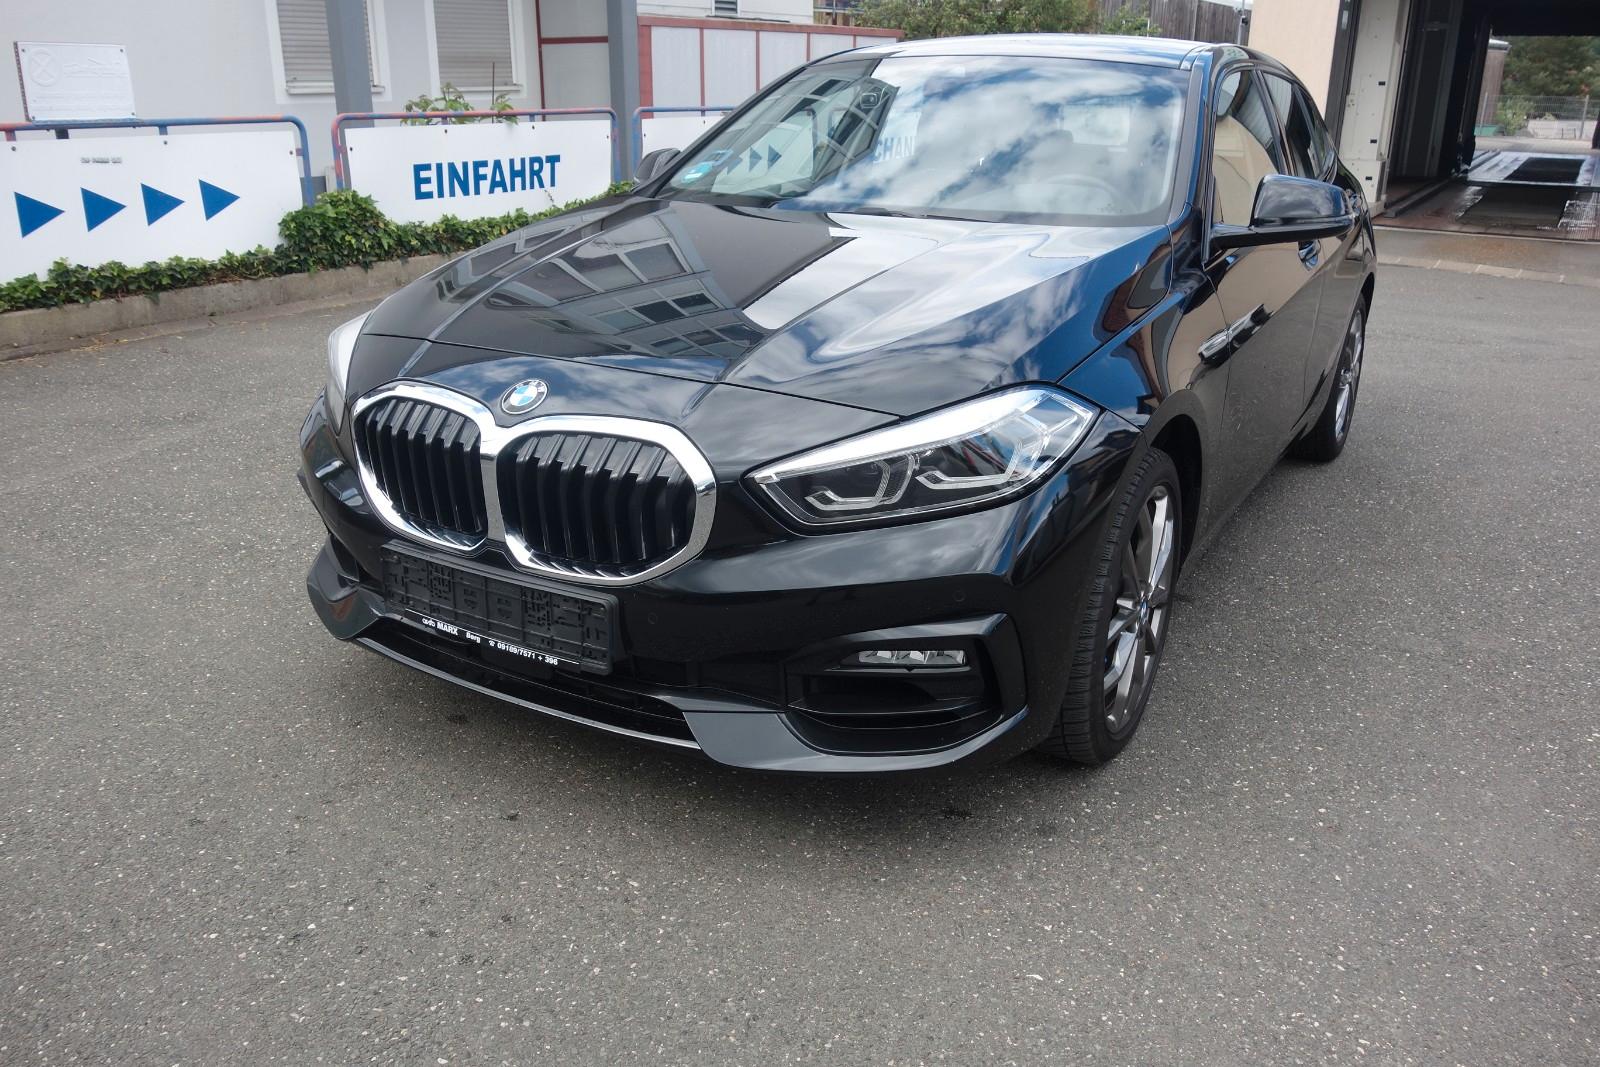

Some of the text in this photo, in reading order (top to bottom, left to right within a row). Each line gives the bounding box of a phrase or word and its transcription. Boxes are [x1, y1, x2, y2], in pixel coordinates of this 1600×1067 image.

[413, 154, 561, 200] EINFAHRT
[436, 620, 459, 636] MARX
[465, 630, 481, 644] Berg
